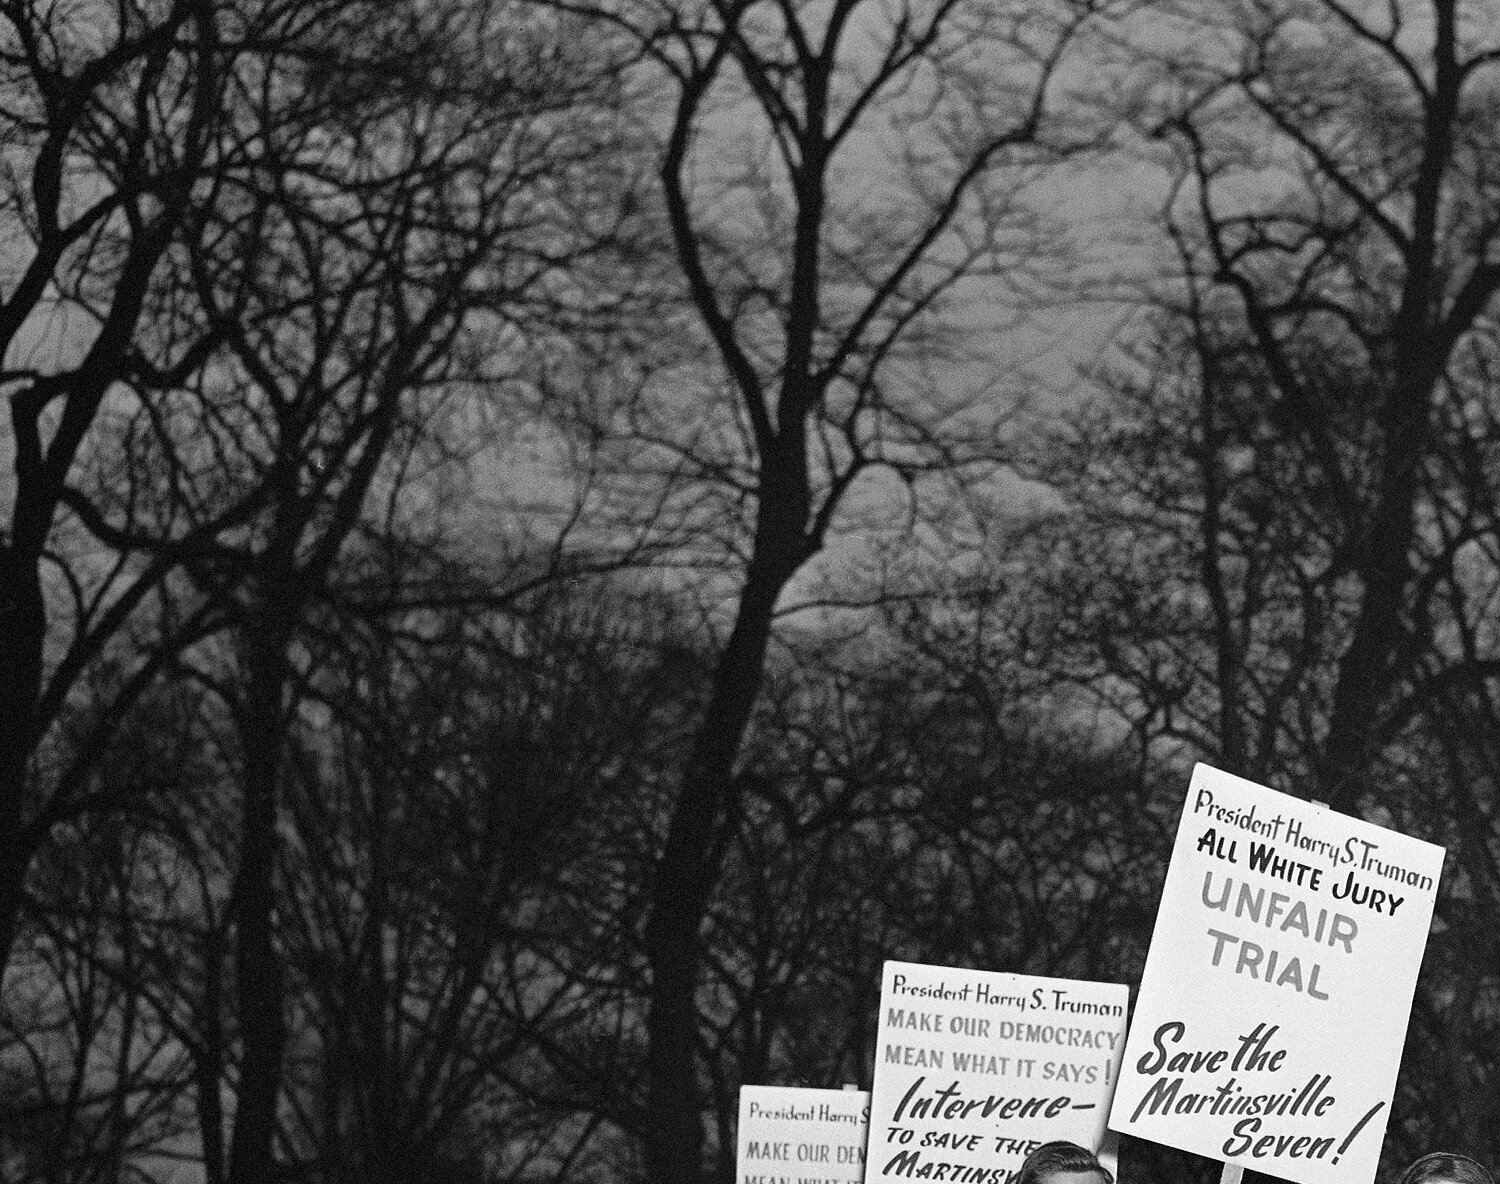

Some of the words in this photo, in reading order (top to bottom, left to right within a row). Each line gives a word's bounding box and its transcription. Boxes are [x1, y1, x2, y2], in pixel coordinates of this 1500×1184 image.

[1194, 788, 1286, 841] President
[1285, 818, 1341, 869] Harry
[1359, 840, 1433, 891] Truman
[1197, 828, 1238, 864] ALL
[1249, 841, 1322, 891] WHITE
[1332, 871, 1405, 916] JURY
[1201, 871, 1359, 954] UNFAIR
[1207, 928, 1330, 1001] TRIAL
[892, 974, 973, 1002] President
[976, 983, 1026, 1012] Harry
[1030, 988, 1046, 1011] S.
[1051, 990, 1123, 1017] Truman
[887, 1007, 944, 1034] MAKE
[950, 1016, 991, 1038] OUR
[1000, 1021, 1121, 1051] DEMOCRACY
[1137, 1021, 1228, 1076] Save
[1230, 1022, 1287, 1073] the
[885, 1044, 944, 1070] MEAN
[952, 1052, 1010, 1077] WHAT
[1016, 1059, 1037, 1079] IT
[750, 1102, 814, 1122] President
[819, 1104, 857, 1126] Harry
[1130, 1073, 1335, 1123] Martinsville
[746, 1142, 790, 1161] MAKE
[797, 1145, 830, 1163] OUR
[887, 1127, 915, 1145] TO
[920, 1131, 984, 1153] SAVE
[995, 1136, 1042, 1157] THE
[1222, 1101, 1385, 1166] Seven!
